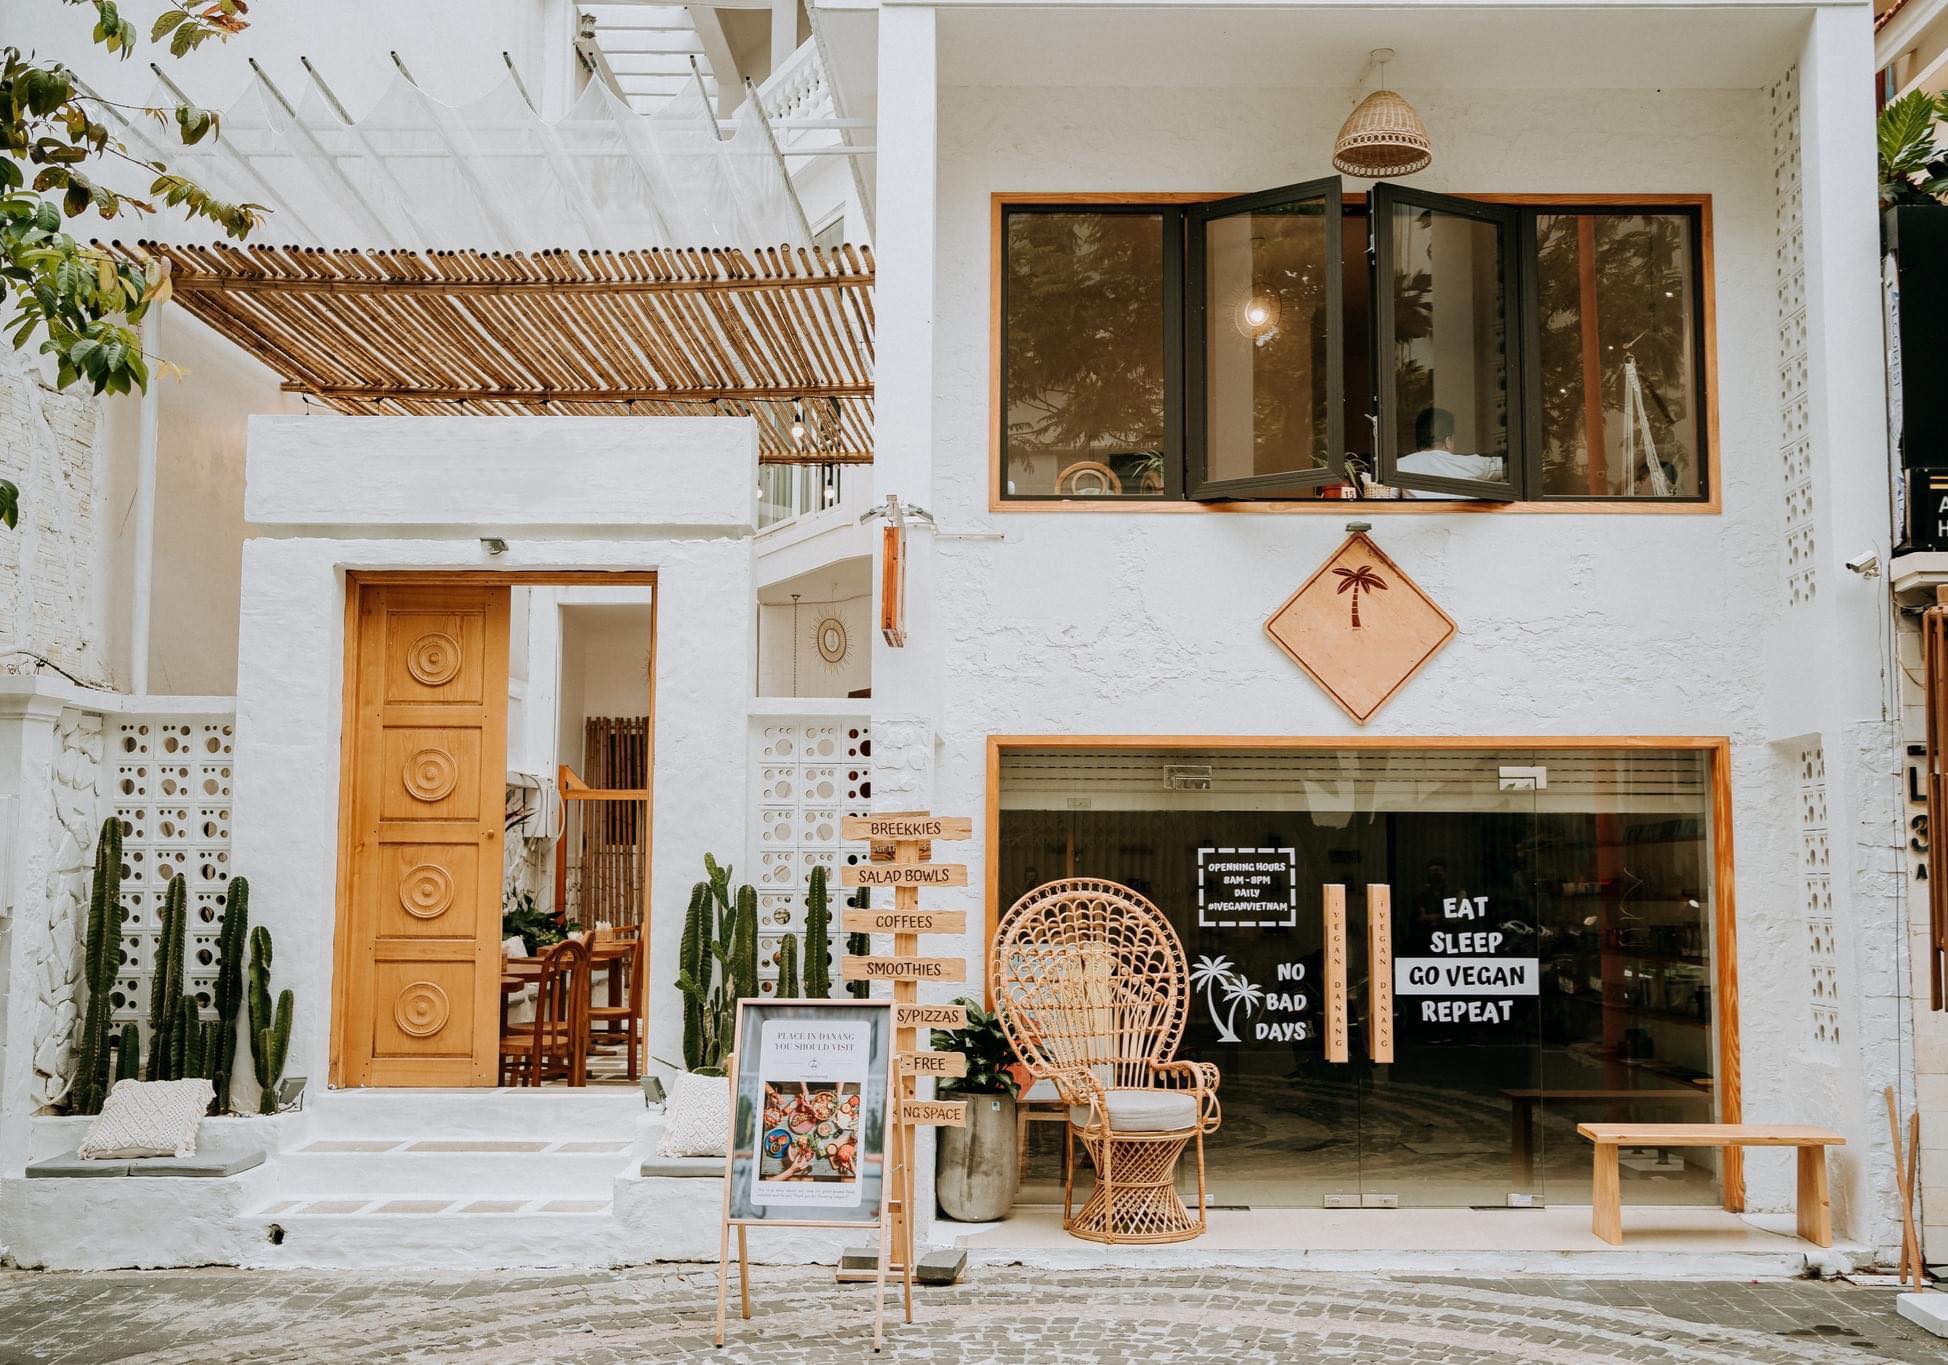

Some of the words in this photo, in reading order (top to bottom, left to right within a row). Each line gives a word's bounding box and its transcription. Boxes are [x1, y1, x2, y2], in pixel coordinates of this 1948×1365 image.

[871, 821, 942, 836] BREEKKIES
[1208, 863, 1255, 872] OPENNING
[1256, 862, 1286, 872] HOURS
[859, 870, 902, 884] SALAD
[905, 869, 950, 883] BOWLS
[1223, 876, 1244, 885] 8AM
[1250, 876, 1271, 885] 8PM
[1234, 889, 1260, 898] DAILY
[1208, 902, 1288, 912] #IVEGANVIETNAM
[1443, 896, 1489, 920] EAT
[876, 915, 933, 929] COFFEES
[1430, 931, 1503, 954] SLEEP
[866, 962, 942, 977] SMOOTHIES
[1277, 963, 1306, 982] NO
[1409, 966, 1440, 986] GO
[1445, 965, 1525, 987] VEGAN
[1265, 993, 1308, 1012] BAD
[897, 1009, 959, 1024] S/PIZZAS
[1334, 981, 1343, 1048] DANANG
[1380, 981, 1389, 1048] DANANG
[1421, 1000, 1514, 1024] REPEAT
[777, 1032, 803, 1040] PLACE
[807, 1032, 816, 1040] IN
[819, 1032, 856, 1041] DANANG
[1255, 1022, 1307, 1042] DAYS
[775, 1043, 790, 1051] YOU
[794, 1043, 830, 1051] SHOULD
[832, 1043, 855, 1052] VISIT
[914, 1057, 946, 1071] FREE
[923, 1106, 961, 1121] SPACE
